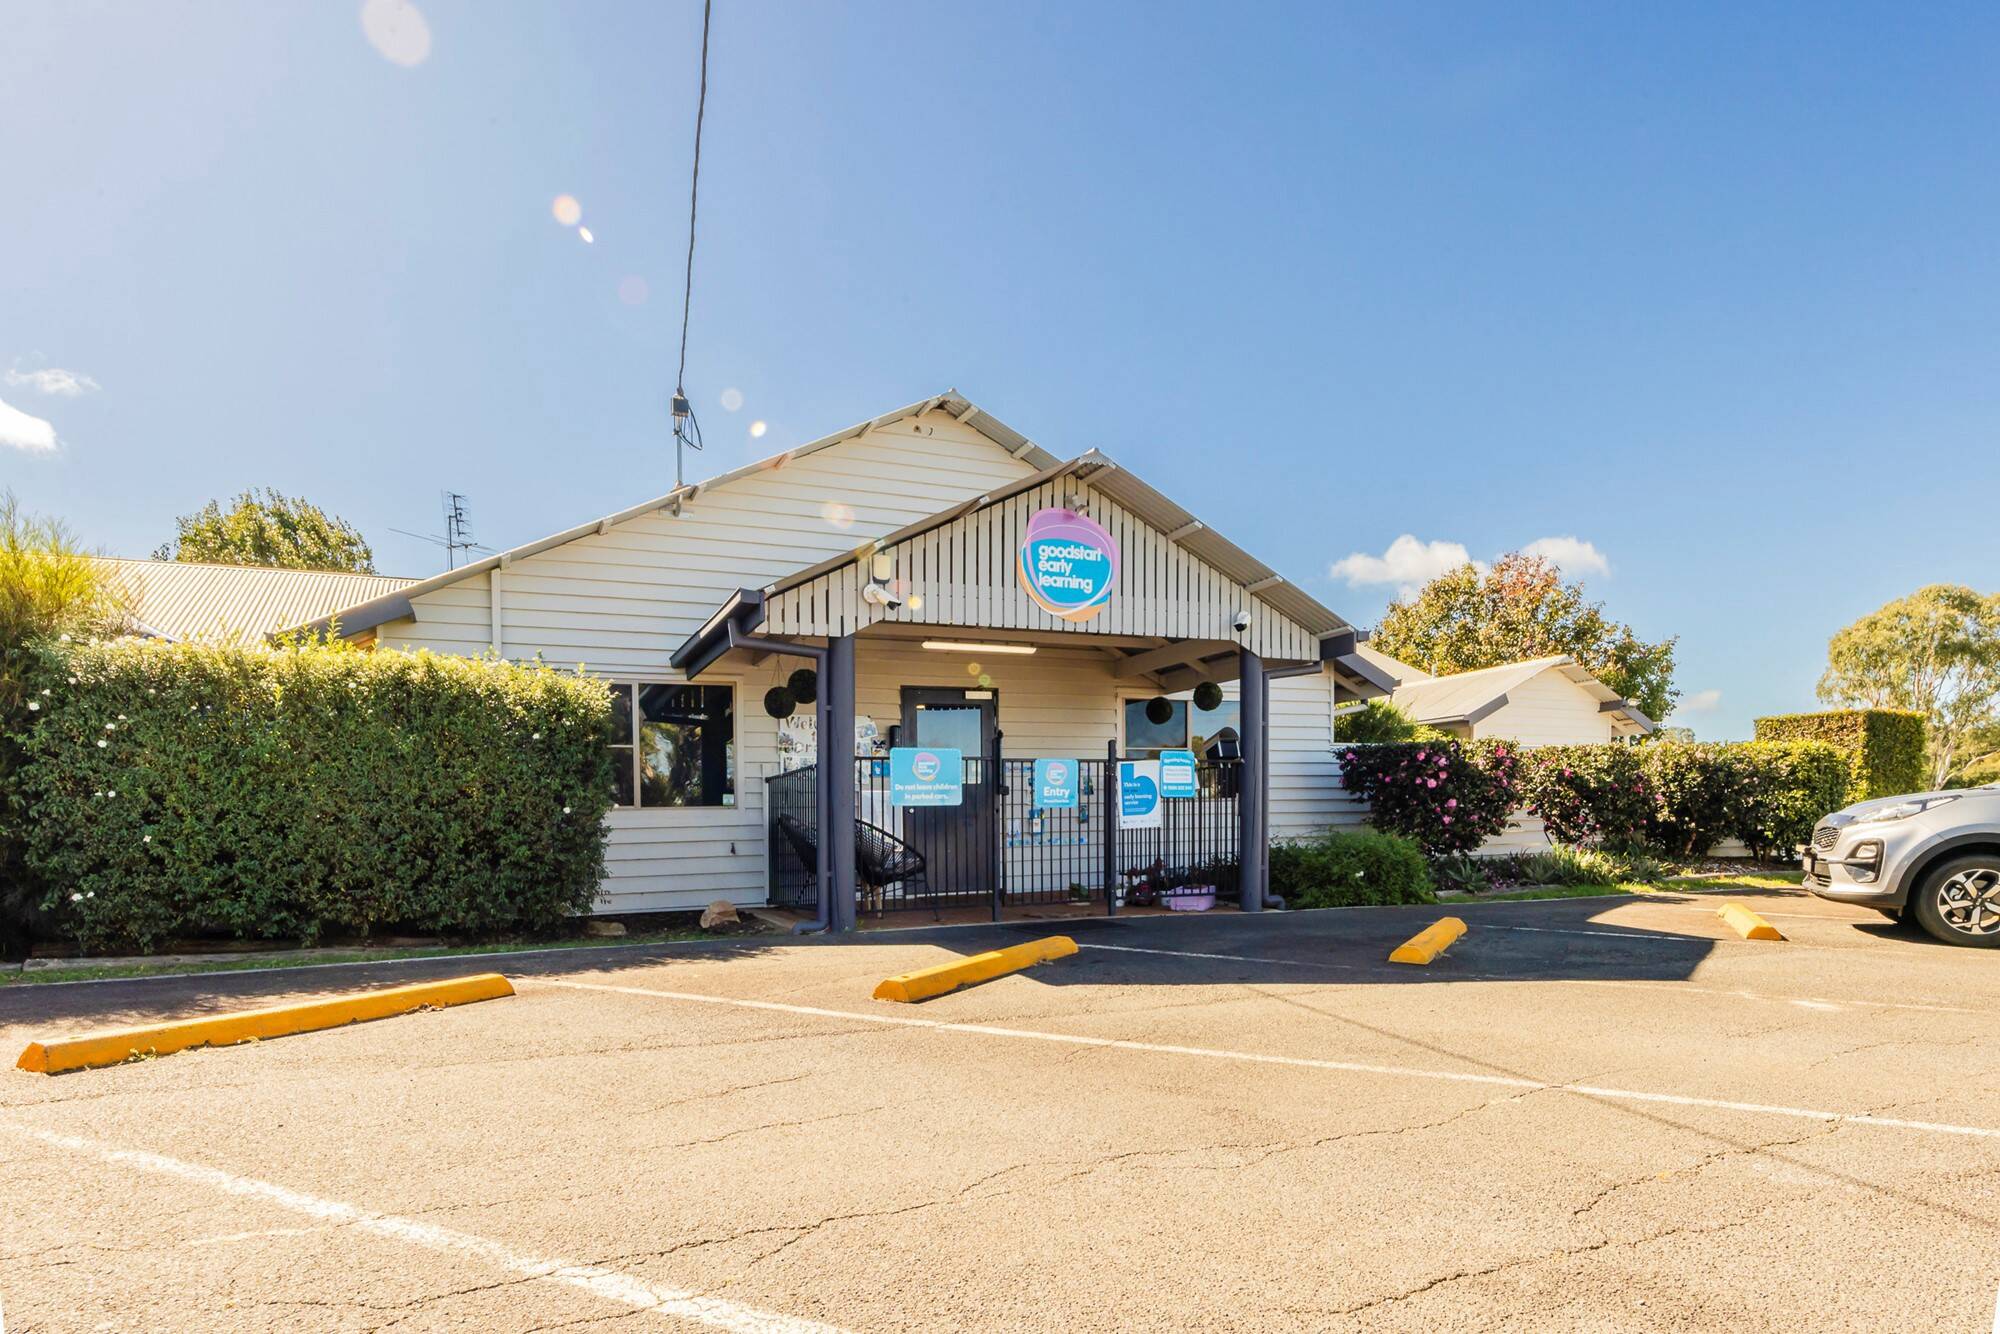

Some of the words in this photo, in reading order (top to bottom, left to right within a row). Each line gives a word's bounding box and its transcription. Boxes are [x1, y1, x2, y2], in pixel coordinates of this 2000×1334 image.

[1038, 545, 1101, 562] goodstart
[1038, 559, 1073, 576] early
[1038, 572, 1093, 594] learning
[1043, 786, 1070, 799] Entry
